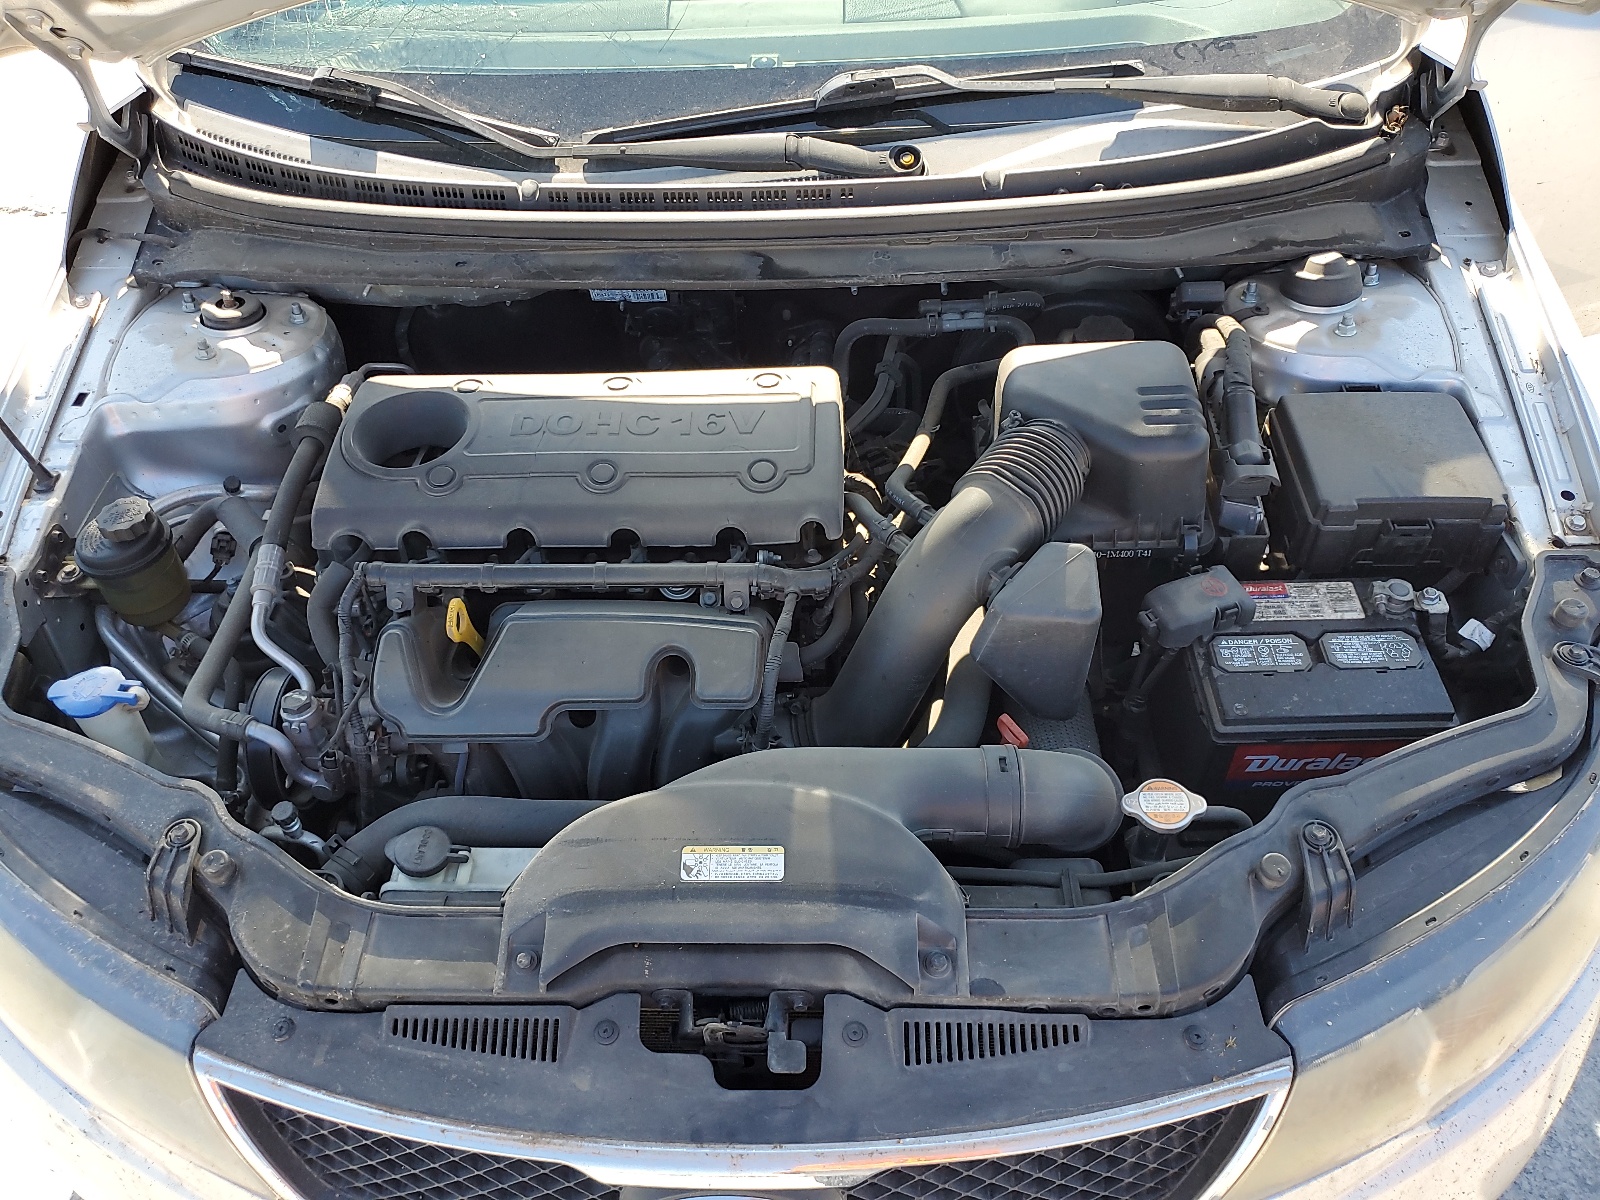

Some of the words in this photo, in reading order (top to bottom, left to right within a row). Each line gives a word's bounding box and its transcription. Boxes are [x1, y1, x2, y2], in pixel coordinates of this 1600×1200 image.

[510, 411, 660, 437] DOHC
[671, 409, 766, 436] 16V
[1095, 549, 1135, 559] 0-1M400
[1244, 585, 1283, 593] Duralast
[1244, 752, 1375, 773] Durala
[1251, 780, 1301, 788] PROV
[413, 829, 433, 867] COOLANT
